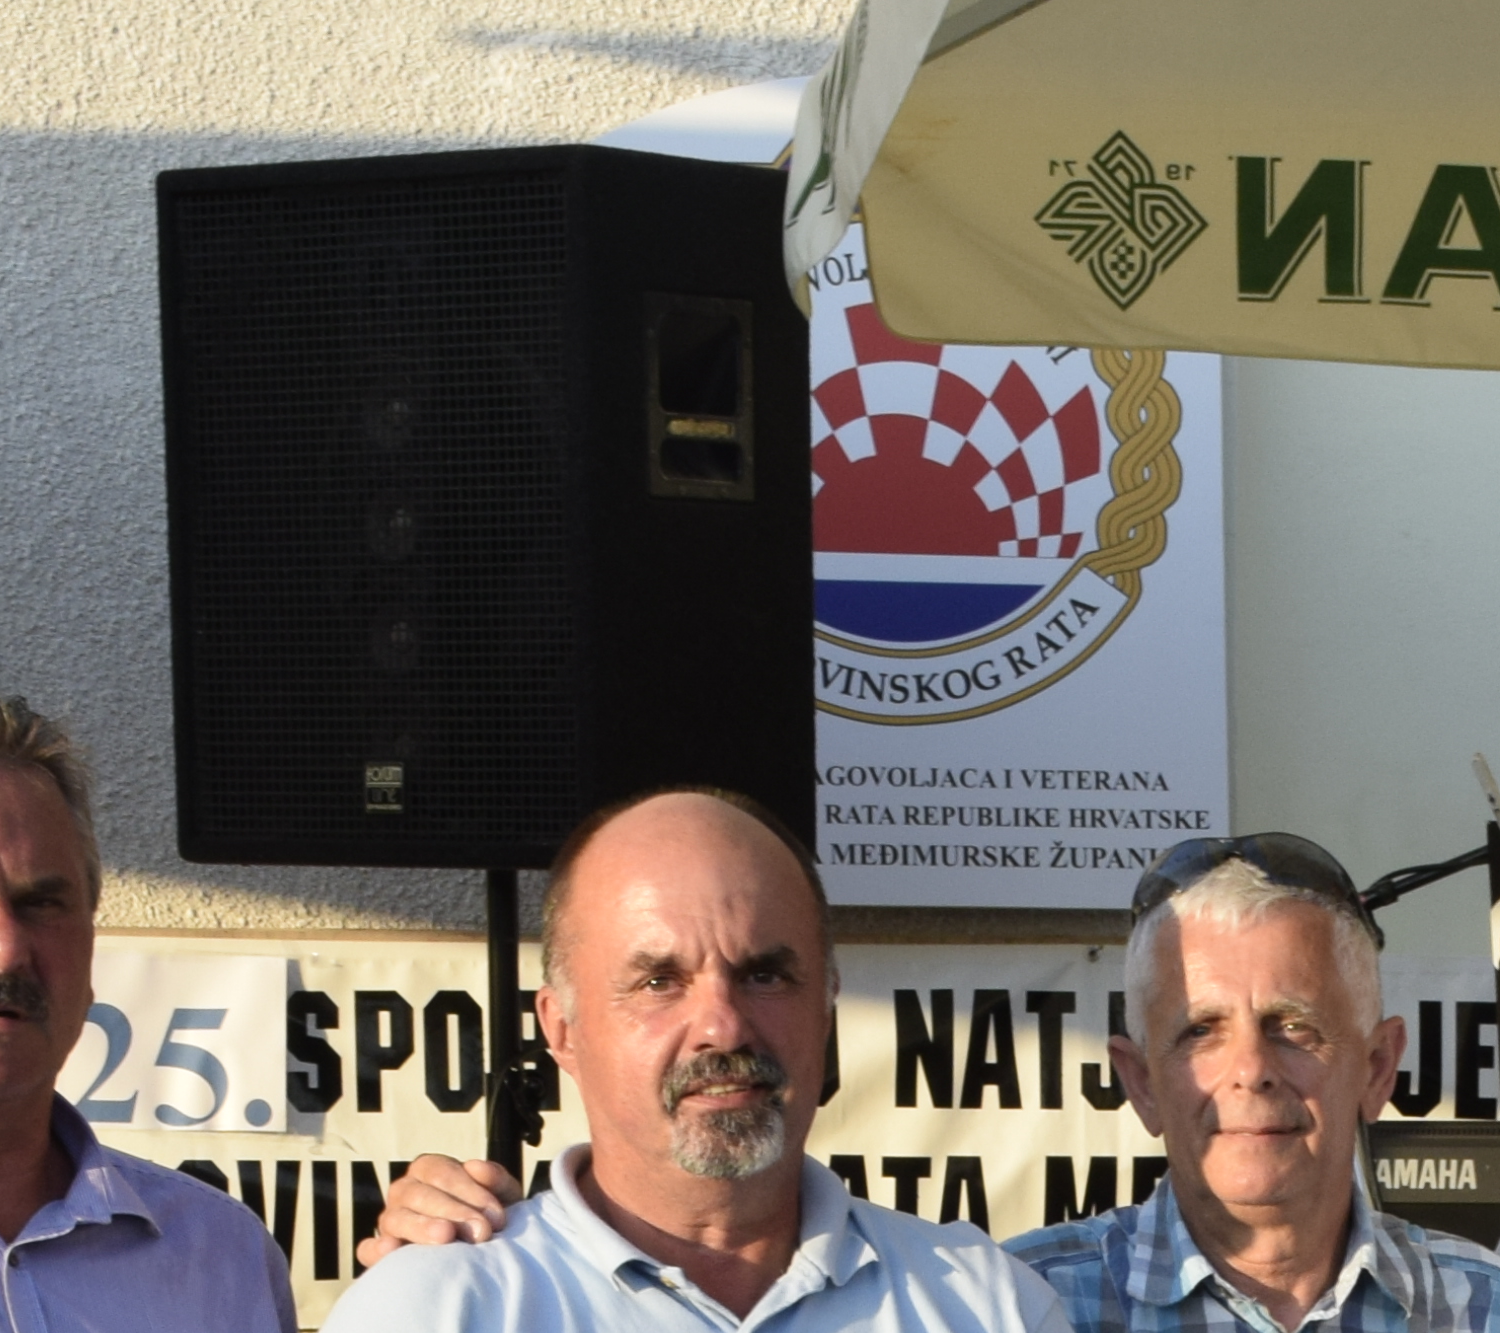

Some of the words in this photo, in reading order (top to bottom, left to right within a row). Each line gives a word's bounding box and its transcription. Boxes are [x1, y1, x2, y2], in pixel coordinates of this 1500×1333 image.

[1003, 598, 1100, 680] RATA
[1005, 769, 1014, 788] I
[1021, 769, 1170, 792] VETERANA
[825, 804, 896, 826] RATA
[903, 806, 1061, 829] REPUBLIKE
[1069, 808, 1211, 830] HRVATSKE
[830, 844, 1041, 868] MEĐIMURSKE
[1374, 1158, 1477, 1190] AMAHA
